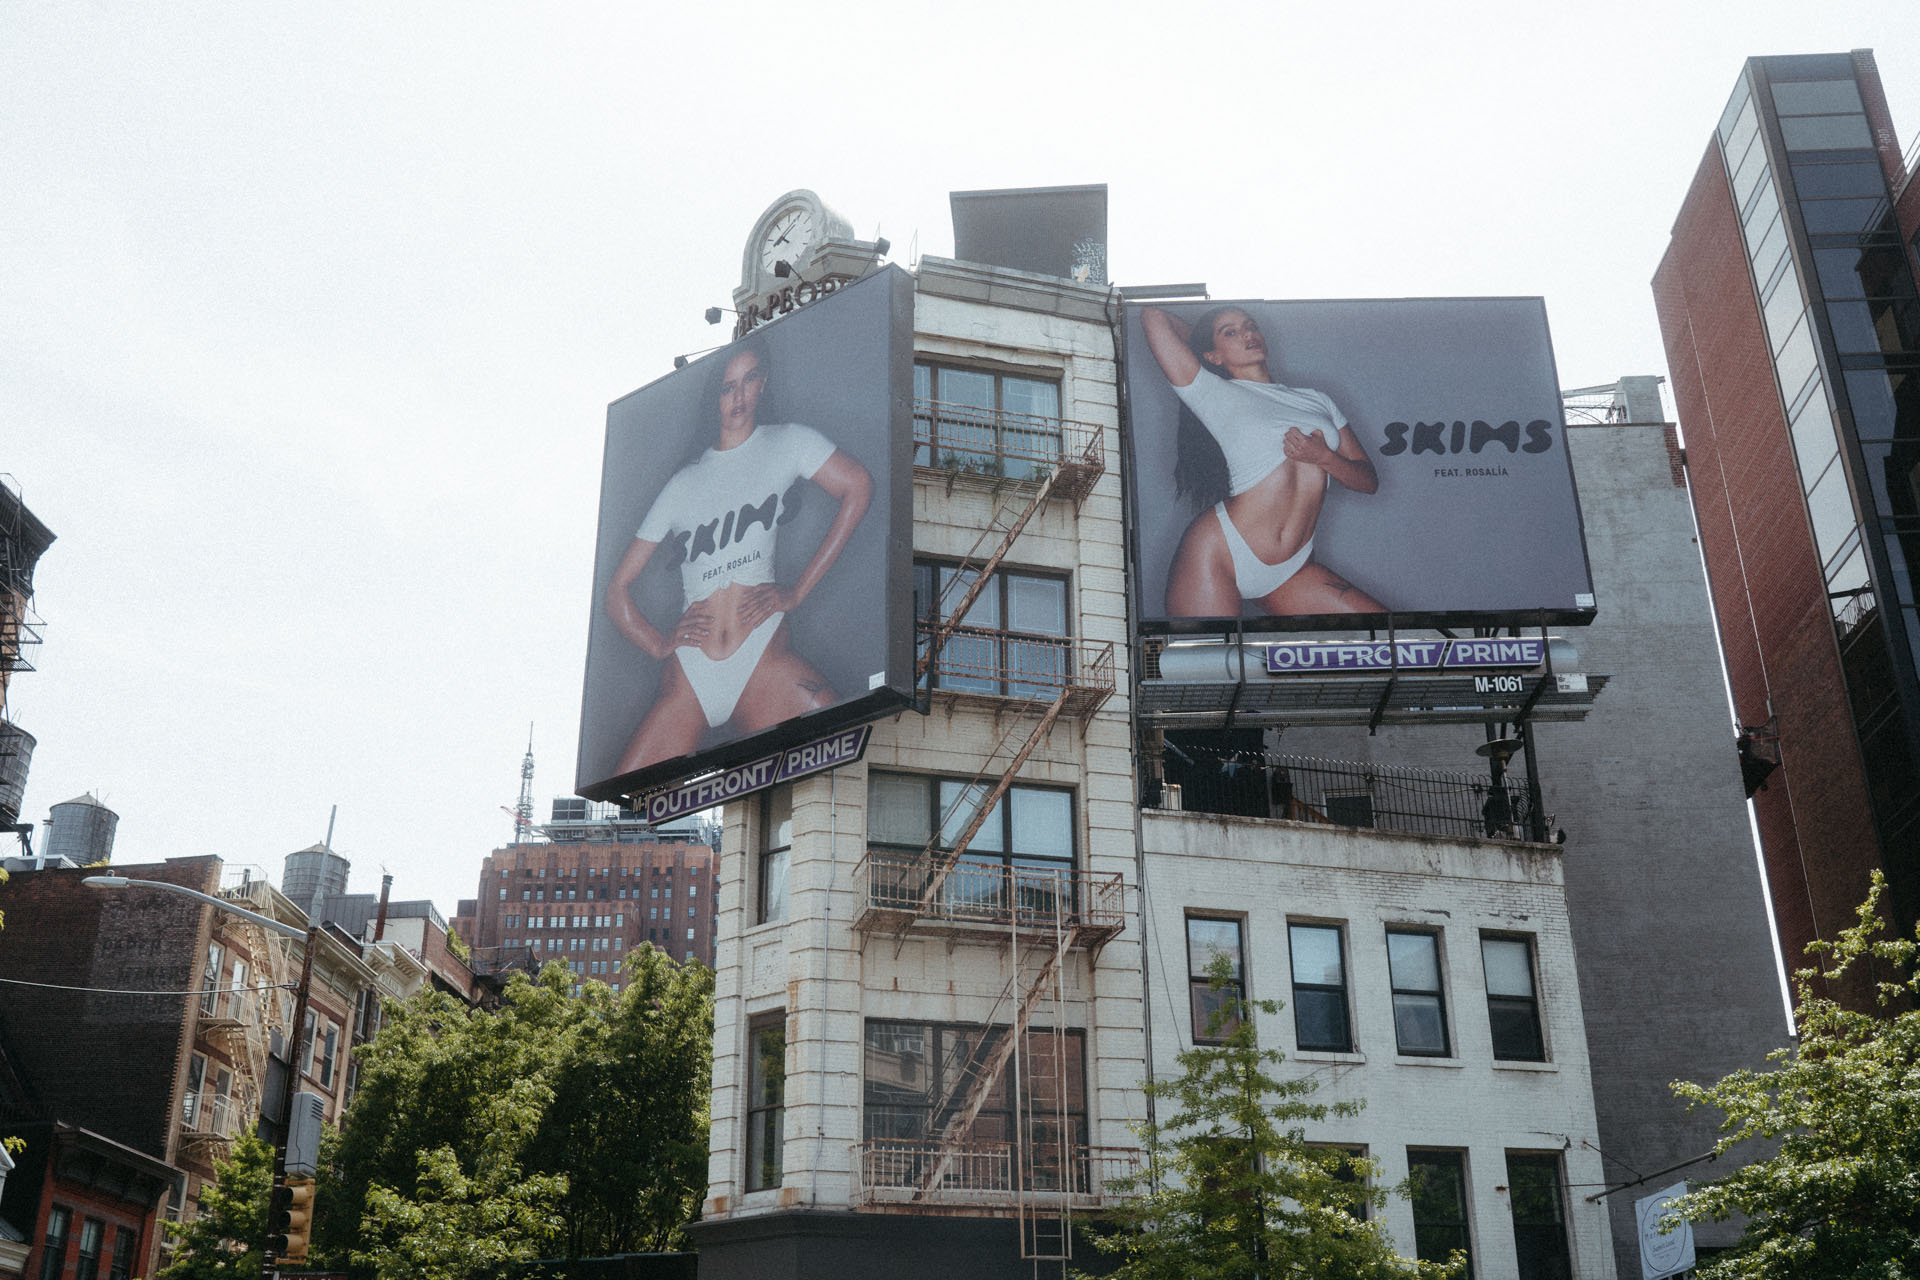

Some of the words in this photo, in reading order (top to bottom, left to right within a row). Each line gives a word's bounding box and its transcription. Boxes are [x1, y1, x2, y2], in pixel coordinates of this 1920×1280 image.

[1379, 419, 1552, 456] SKIMS
[1434, 468, 1463, 477] FEAT.
[702, 564, 725, 582] FEAT.
[726, 550, 761, 572] ROSALÍA
[1274, 643, 1437, 668] OUTFRONT
[1457, 643, 1540, 662] PRIME
[1475, 676, 1523, 693] M-1061
[652, 759, 773, 818] OUTFRONT
[787, 734, 856, 774] PRIME
